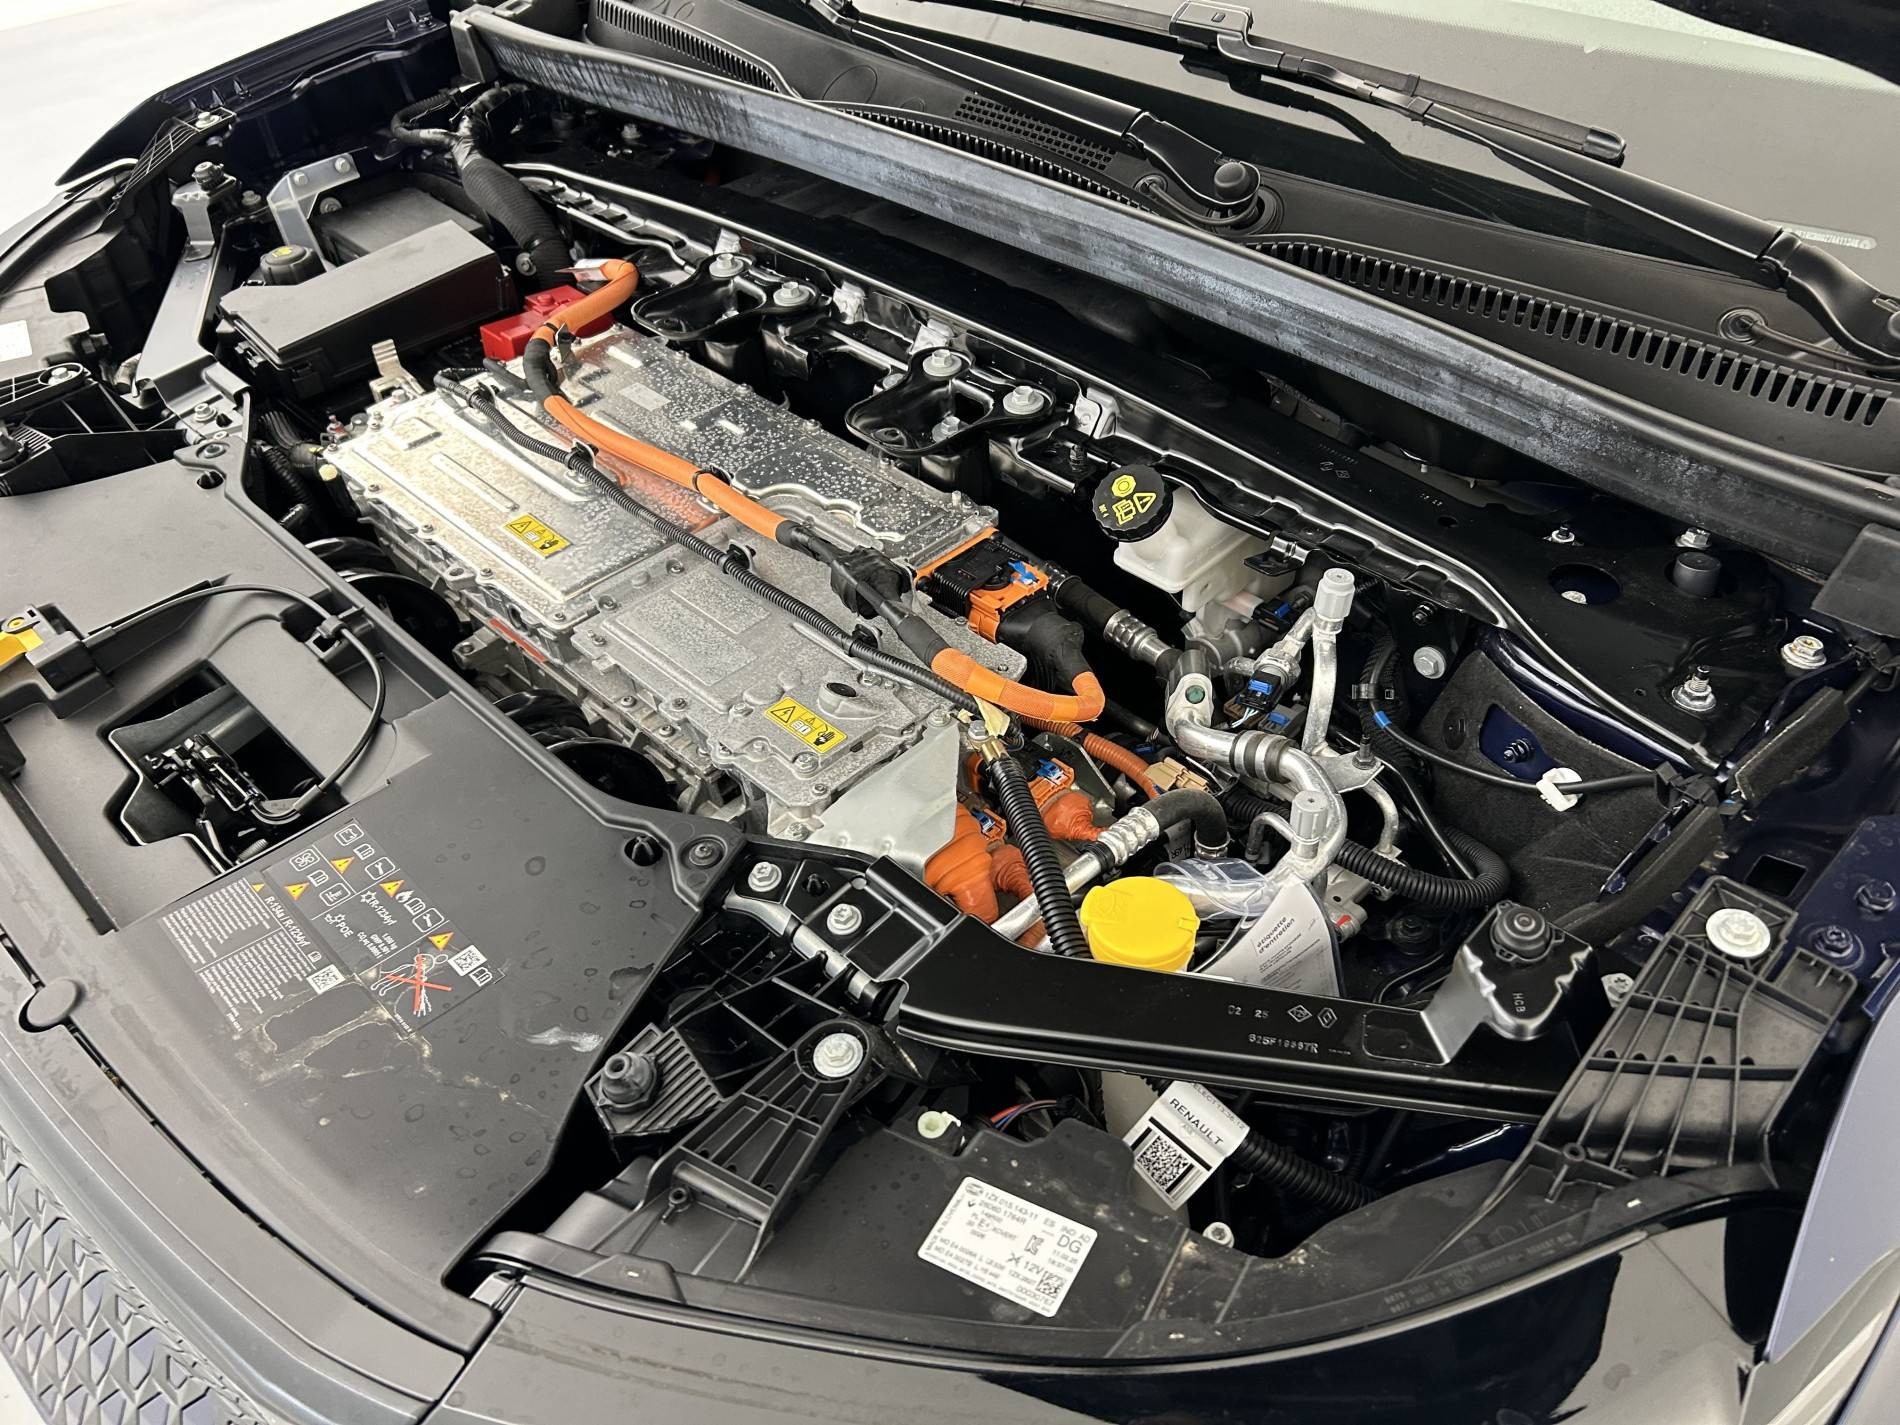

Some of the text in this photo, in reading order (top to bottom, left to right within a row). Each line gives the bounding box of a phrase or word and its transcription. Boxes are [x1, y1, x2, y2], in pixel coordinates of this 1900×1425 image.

[369, 899, 397, 925] R-1234yf
[282, 920, 310, 947] R-1234yf
[335, 921, 354, 938] POE
[1170, 1098, 1224, 1145] RENAULT
[1056, 1234, 1082, 1254] DG
[1022, 1260, 1043, 1276] 12V
